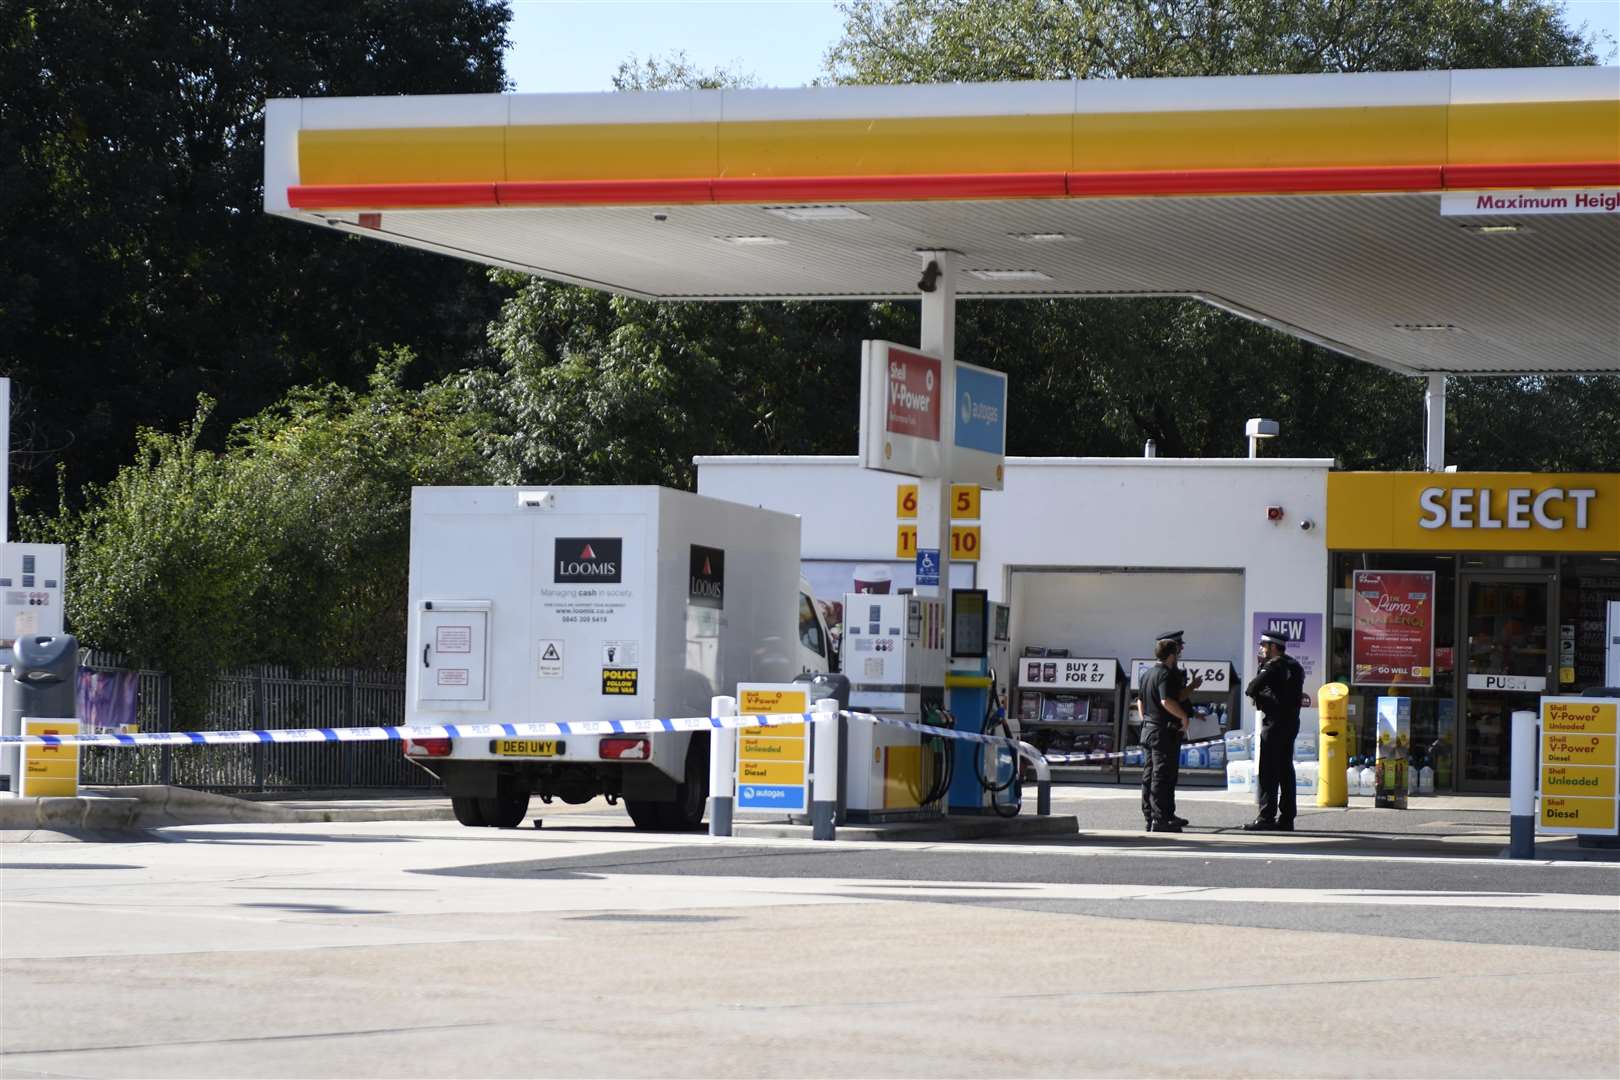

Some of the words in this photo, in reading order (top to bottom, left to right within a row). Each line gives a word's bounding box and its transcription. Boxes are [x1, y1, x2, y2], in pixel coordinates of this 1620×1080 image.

[1476, 195, 1567, 209] Maximum
[890, 361, 907, 381] Shell
[890, 381, 931, 412] V-Power
[972, 402, 999, 425] autogas
[903, 491, 917, 511] 6
[957, 492, 970, 511] 5
[1418, 488, 1597, 530] SELECT
[952, 532, 976, 552] 10
[559, 560, 616, 575] LOOMIS
[691, 575, 721, 598] LOOMIS
[540, 588, 577, 598] Managing
[579, 588, 597, 597] cash
[599, 589, 606, 597] in
[1270, 620, 1303, 640] NEW
[1066, 663, 1088, 672] BUY
[1092, 663, 1099, 672] 2
[1391, 666, 1408, 674] WELL
[603, 670, 637, 680] POLICE
[1066, 673, 1088, 682] FOR
[1091, 673, 1105, 682] £7
[1204, 668, 1225, 681] £6
[746, 697, 779, 705] V-Power
[1550, 711, 1597, 721] V-Power
[1549, 722, 1585, 730] Unleaded
[503, 741, 528, 753] DE61
[531, 741, 553, 753] UWY
[745, 745, 782, 753] Unleaded
[1549, 743, 1596, 753] V-Power
[1548, 754, 1571, 762] Diesel
[744, 768, 767, 776] Diesel
[1548, 767, 1566, 775] Shell
[1548, 776, 1599, 786] Unleaded
[755, 788, 785, 799] autogas
[1547, 799, 1565, 807] Shell
[1546, 808, 1579, 819] Diesel
